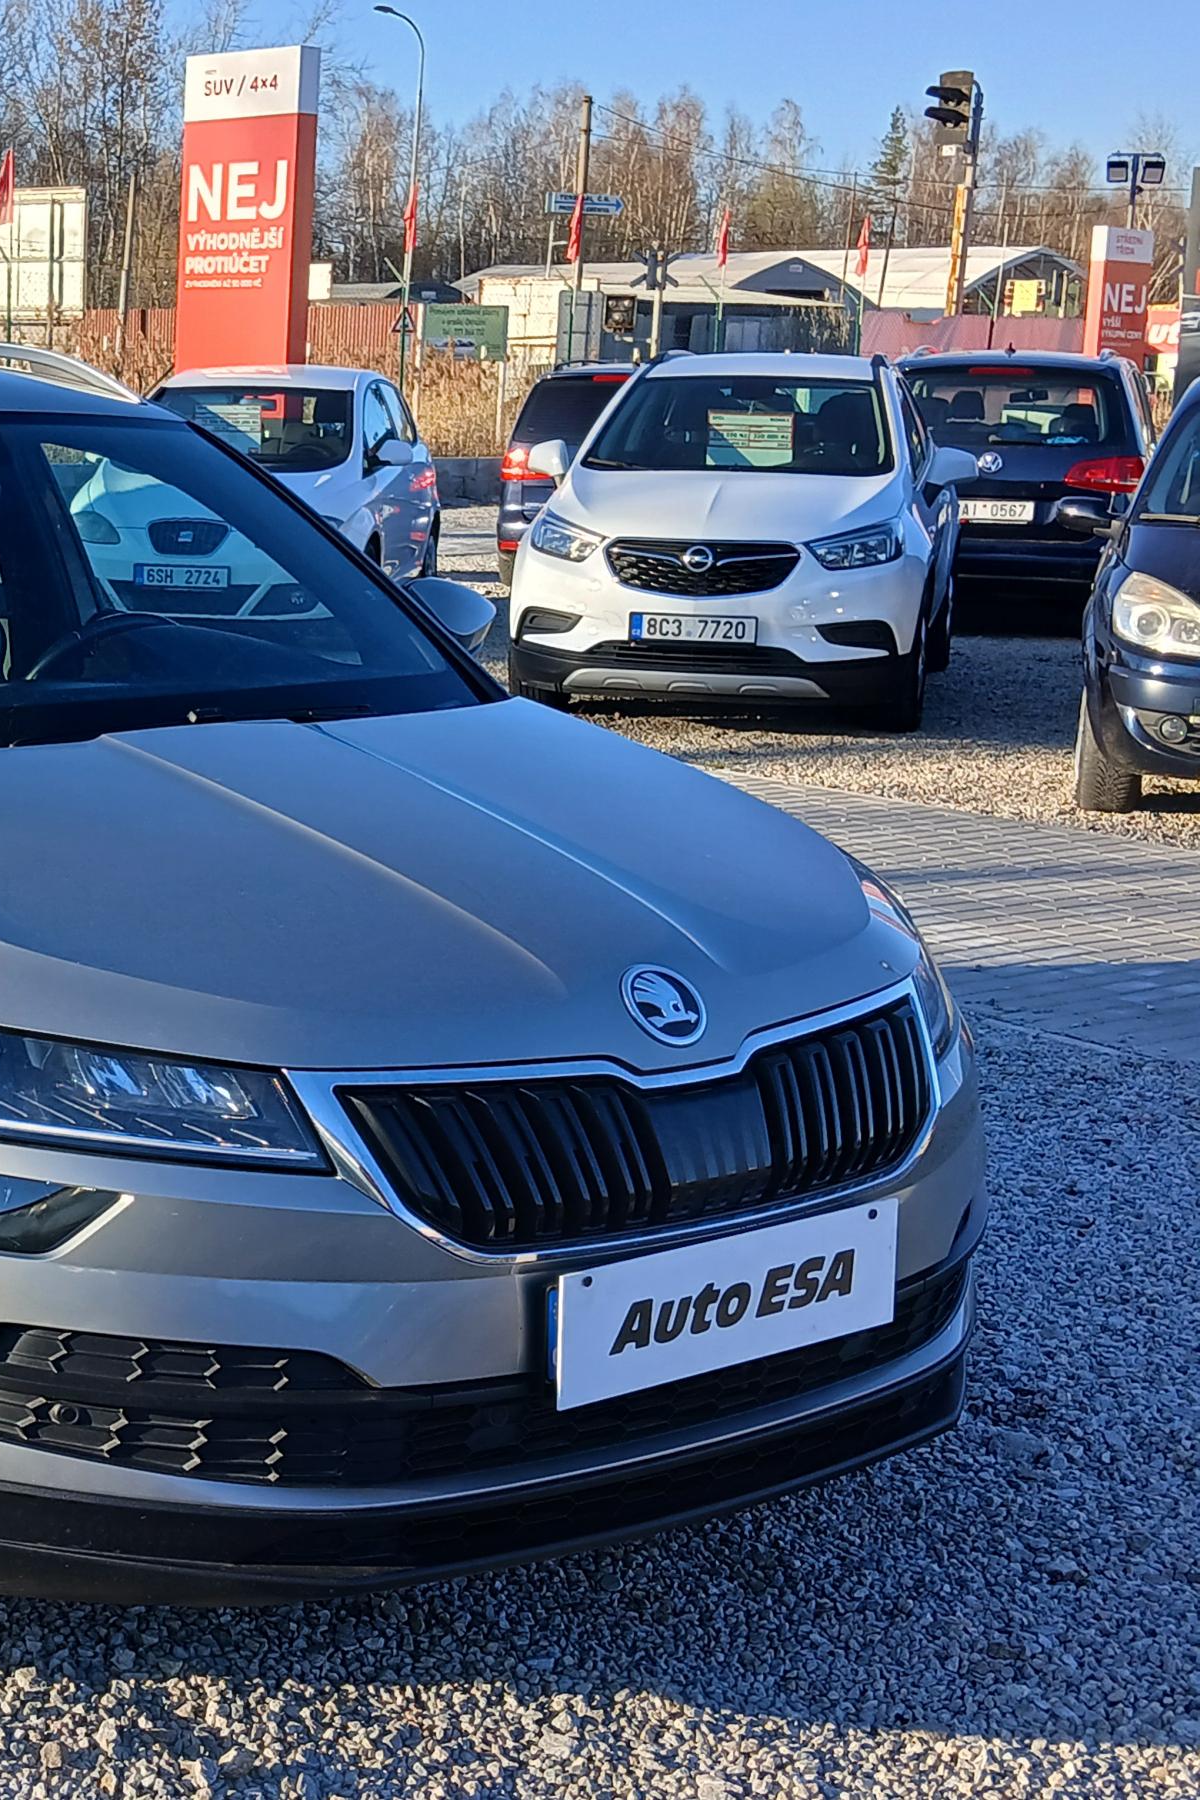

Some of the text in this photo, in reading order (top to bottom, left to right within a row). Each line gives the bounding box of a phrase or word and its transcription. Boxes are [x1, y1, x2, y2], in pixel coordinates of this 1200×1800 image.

[204, 78, 234, 97] SUV
[250, 74, 278, 93] 4x4
[187, 159, 288, 222] NEJ
[186, 226, 284, 251] VÝHODNĚJŠÍ
[185, 251, 270, 275] PROTIÚČET
[1103, 282, 1147, 314] NEJ
[959, 503, 1026, 517] AI 0567
[146, 568, 220, 586] 6SH 2724
[646, 617, 746, 640] 8C3 7720
[608, 1248, 855, 1357] Auto ESA
